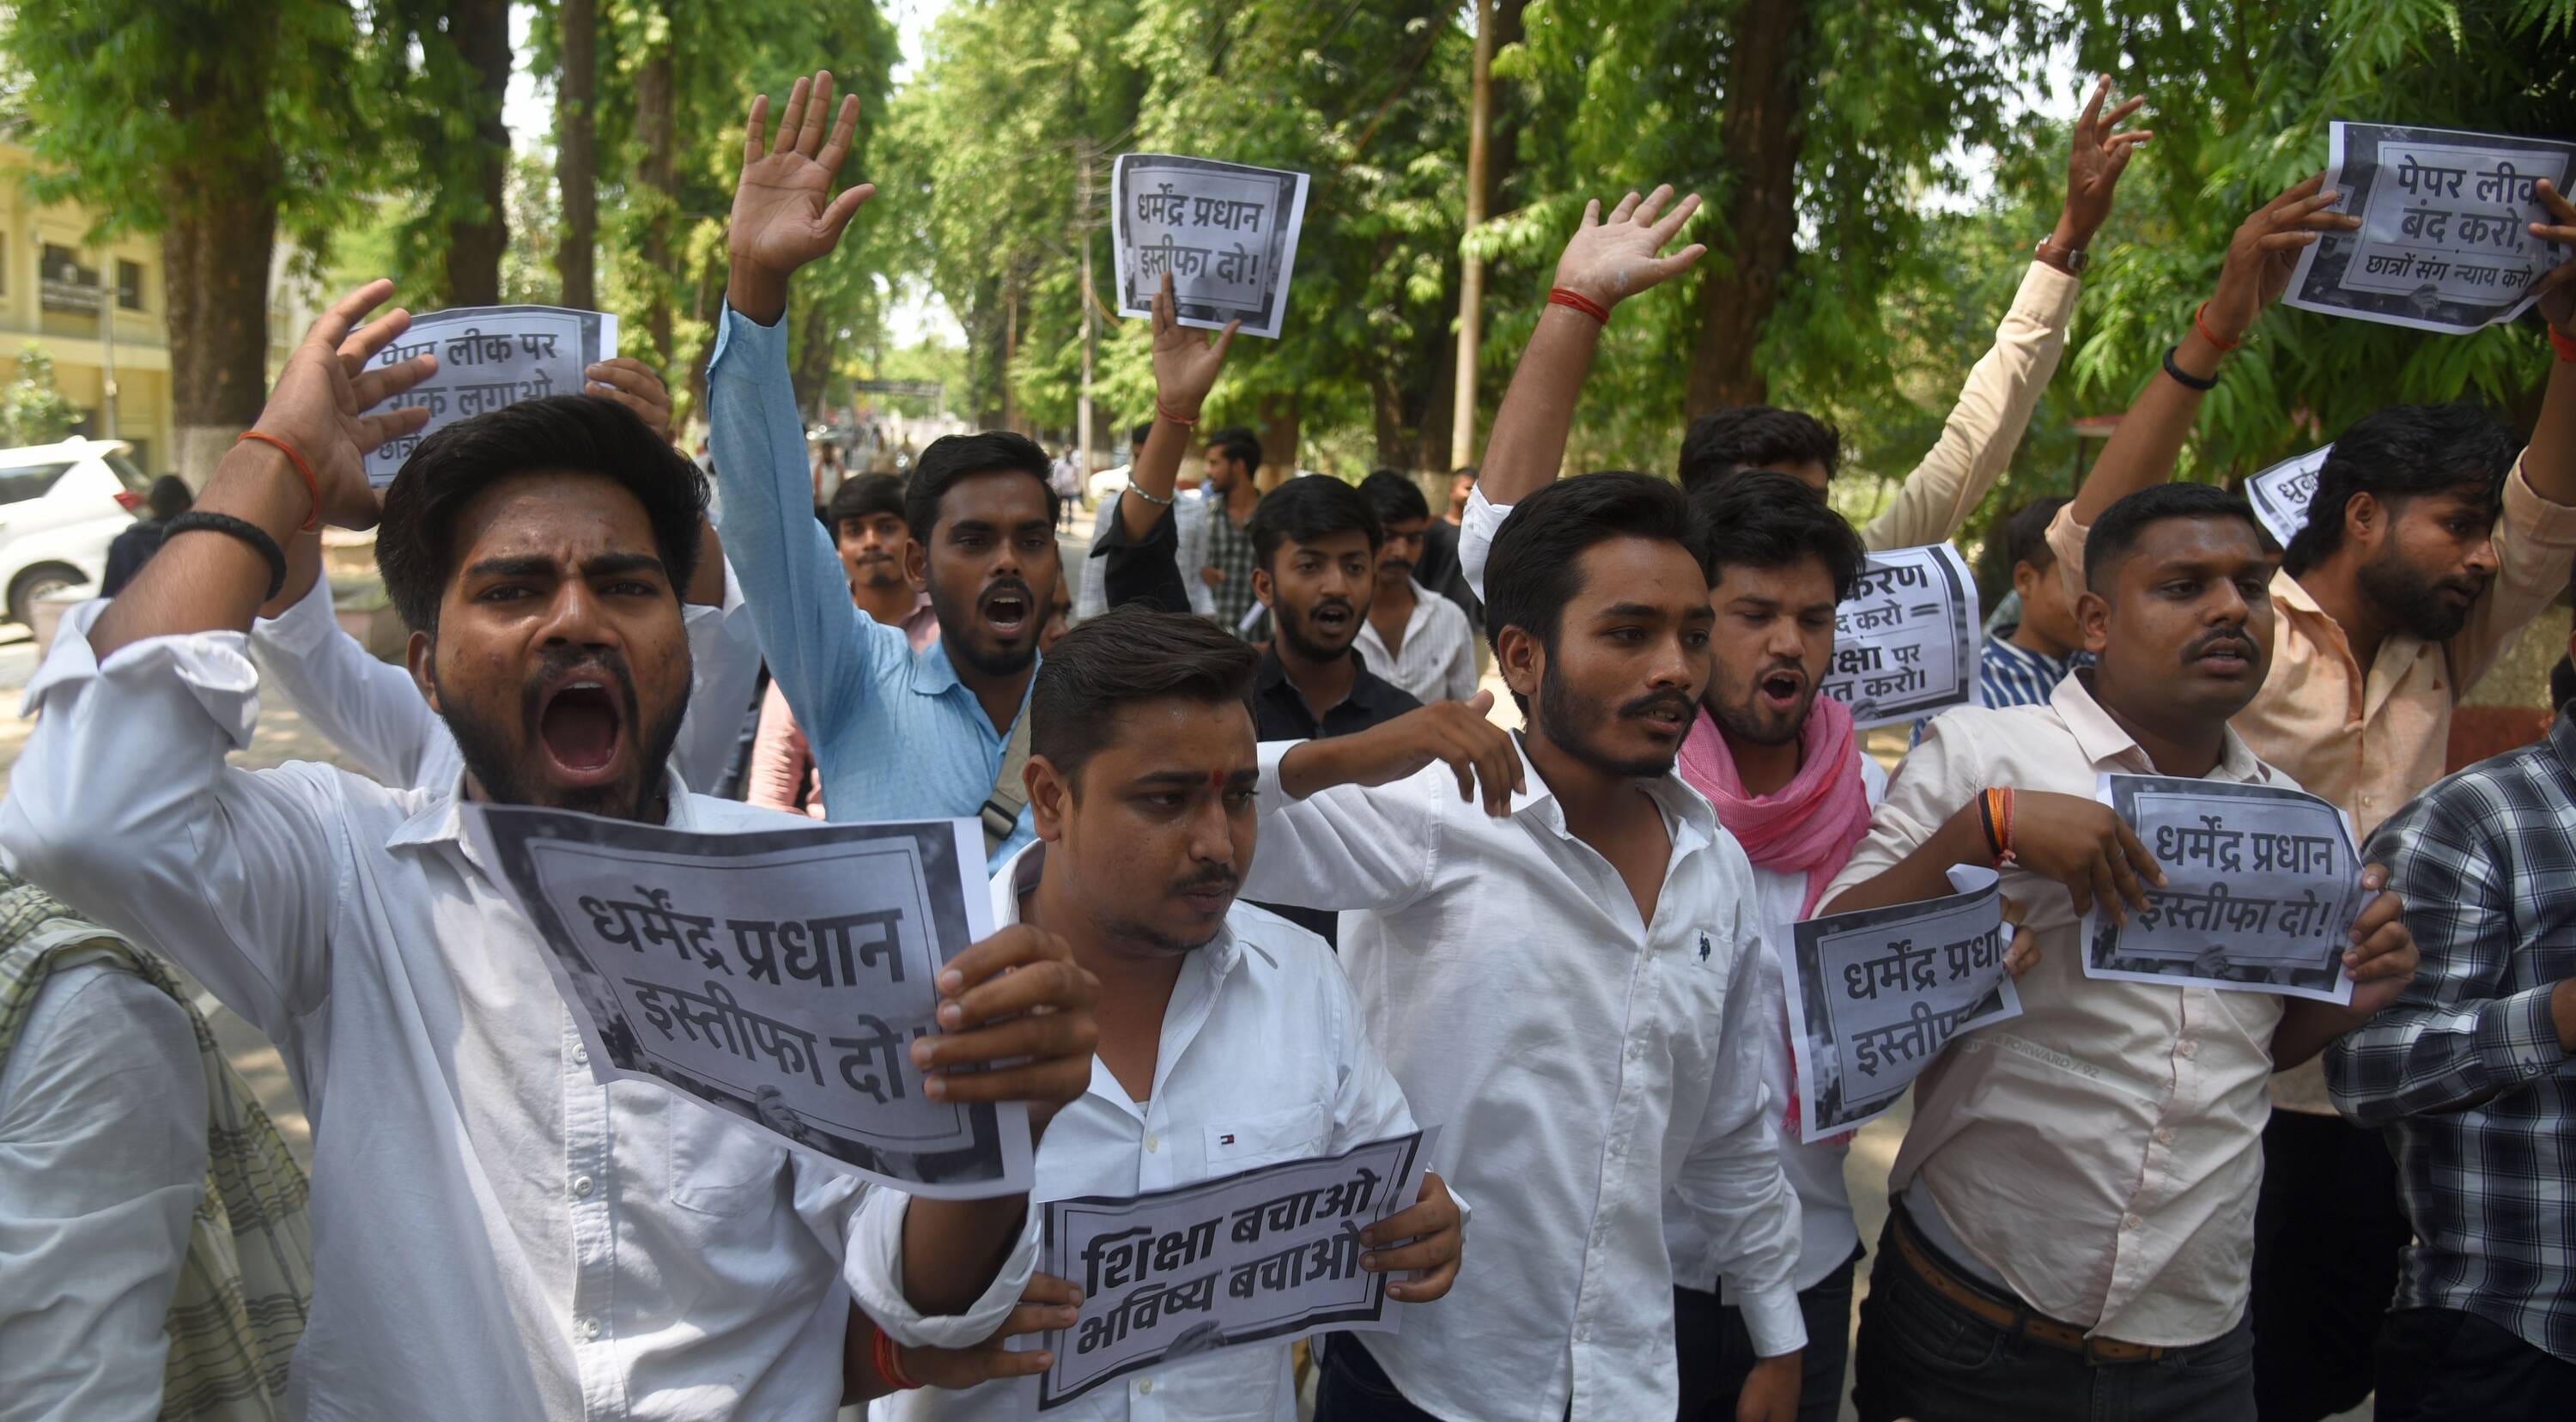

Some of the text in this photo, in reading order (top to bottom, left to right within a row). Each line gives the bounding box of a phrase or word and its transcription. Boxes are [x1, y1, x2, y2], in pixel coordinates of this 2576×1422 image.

[2397, 155, 2466, 199] पेपर
[1138, 183, 1265, 233] धर्मेंद्र प्रधान
[2402, 198, 2525, 253] बंद करो,
[1140, 234, 1259, 286] इस्तीफा दो!
[2365, 252, 2415, 278] छात्रों
[2415, 255, 2449, 282] संग
[2454, 264, 2500, 287] न्याय
[445, 327, 513, 366] लीक
[519, 332, 558, 362] पर
[1846, 564, 1929, 601] करण
[1852, 599, 1903, 631] करो
[1828, 643, 1922, 677] क्षा पर
[2156, 816, 2335, 876] धर्मेंद्र प्रधान
[2139, 882, 2331, 938] इस्तीफा दो!
[578, 885, 905, 988] धर्मेंद्र प्रधान
[1844, 925, 2002, 1000] धर्मेंद्र प्रधा
[623, 980, 927, 1105] इस्तीफा दो
[2005, 1036, 2071, 1066] FORWARD
[2081, 1064, 2100, 1079] 92
[1081, 1168, 1382, 1299] शिक्षा बचाओ
[1077, 1219, 1364, 1355] भविष्य बचाओ
